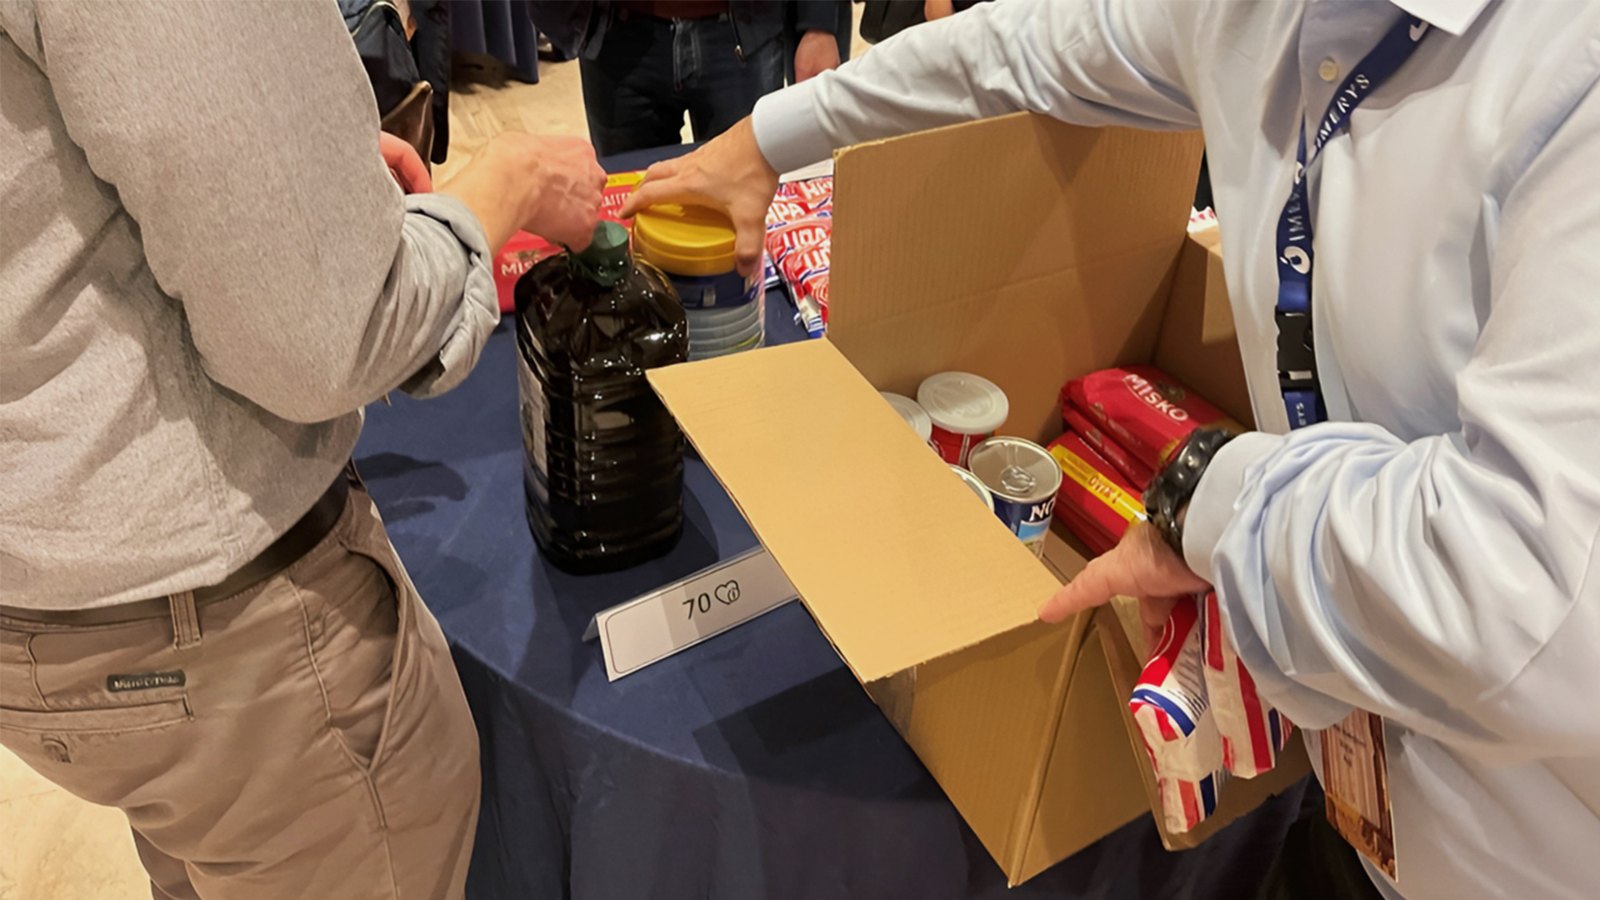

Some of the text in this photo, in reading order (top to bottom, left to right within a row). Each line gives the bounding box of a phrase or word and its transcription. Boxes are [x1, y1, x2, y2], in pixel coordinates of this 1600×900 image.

[501, 260, 540, 277] MIS
[1121, 373, 1189, 422] MISKO
[682, 592, 711, 620] 70
